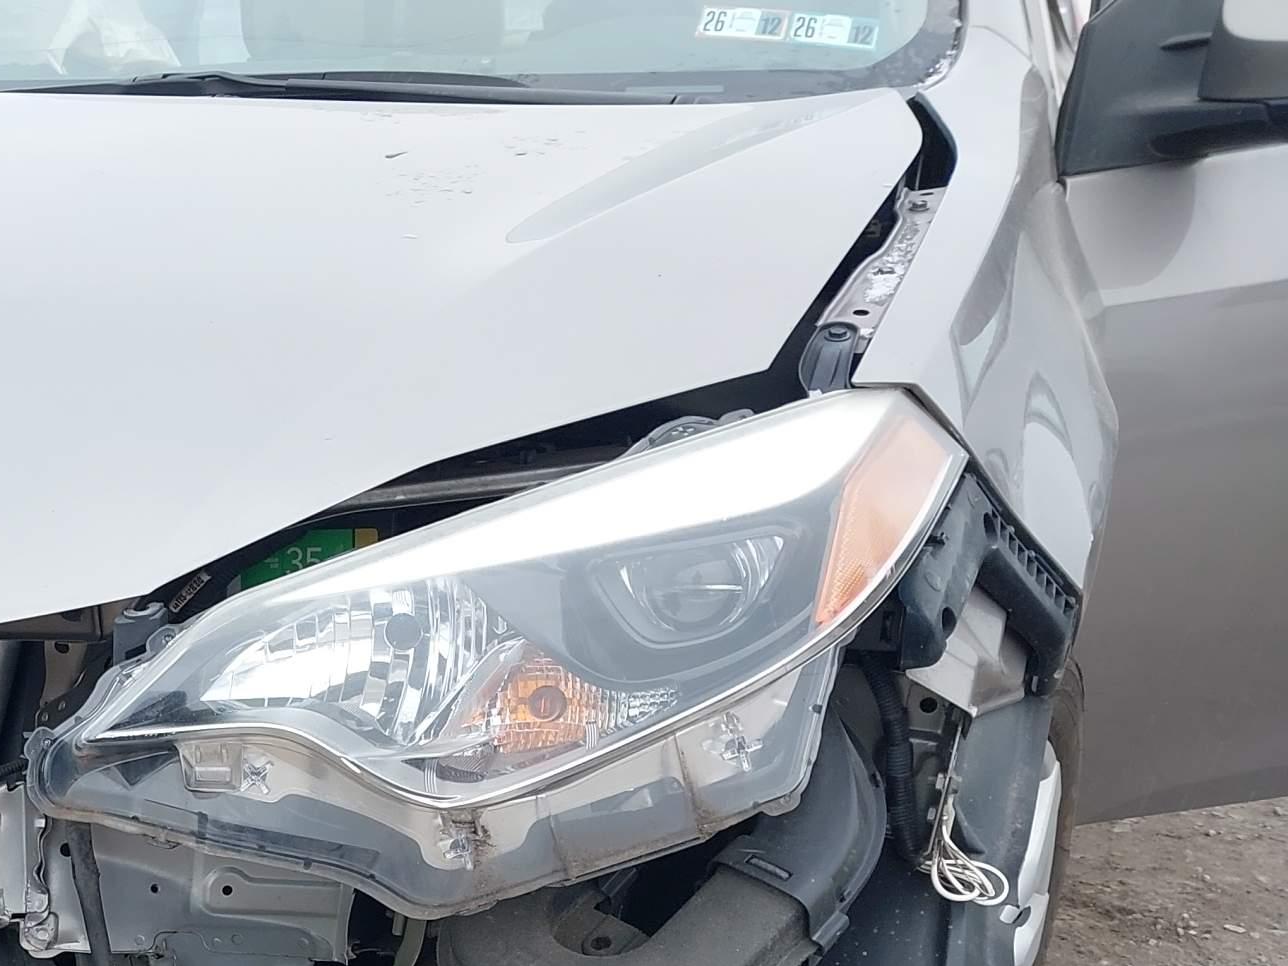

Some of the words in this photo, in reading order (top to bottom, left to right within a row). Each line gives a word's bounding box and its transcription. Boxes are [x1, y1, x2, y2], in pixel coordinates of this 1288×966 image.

[702, 10, 727, 32] 26
[760, 16, 783, 36] 12
[793, 16, 818, 39] 26
[852, 25, 874, 45] 12
